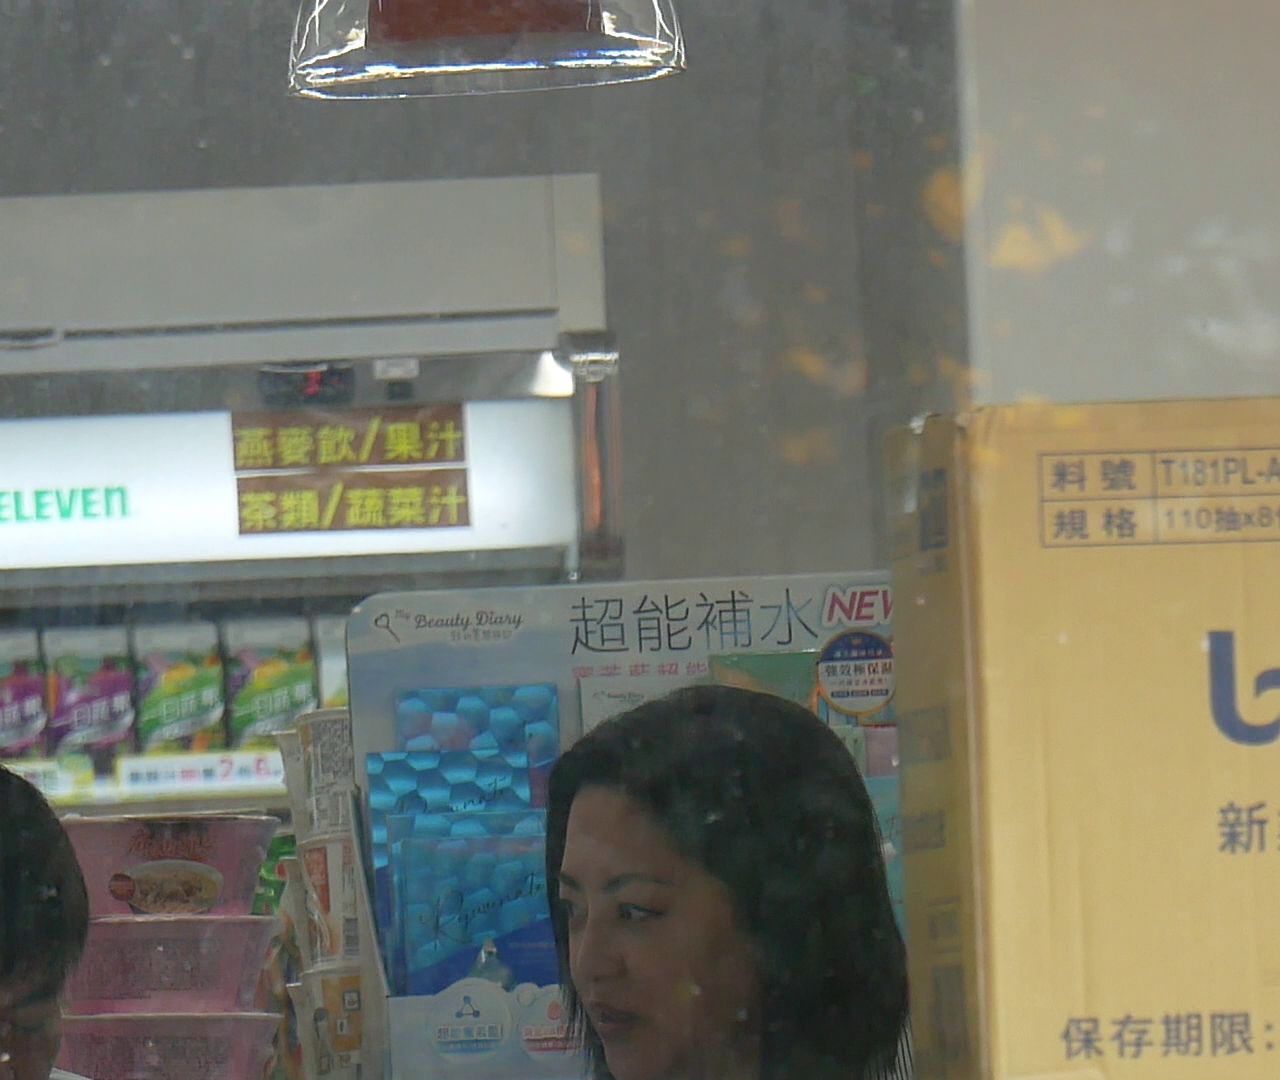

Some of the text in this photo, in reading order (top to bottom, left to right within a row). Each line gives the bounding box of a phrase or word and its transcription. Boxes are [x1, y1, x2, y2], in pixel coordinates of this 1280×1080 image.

[1054, 507, 1137, 539] 規格
[414, 612, 471, 630] Beauty
[476, 610, 524, 629] Diary
[570, 588, 819, 654] 超能補水
